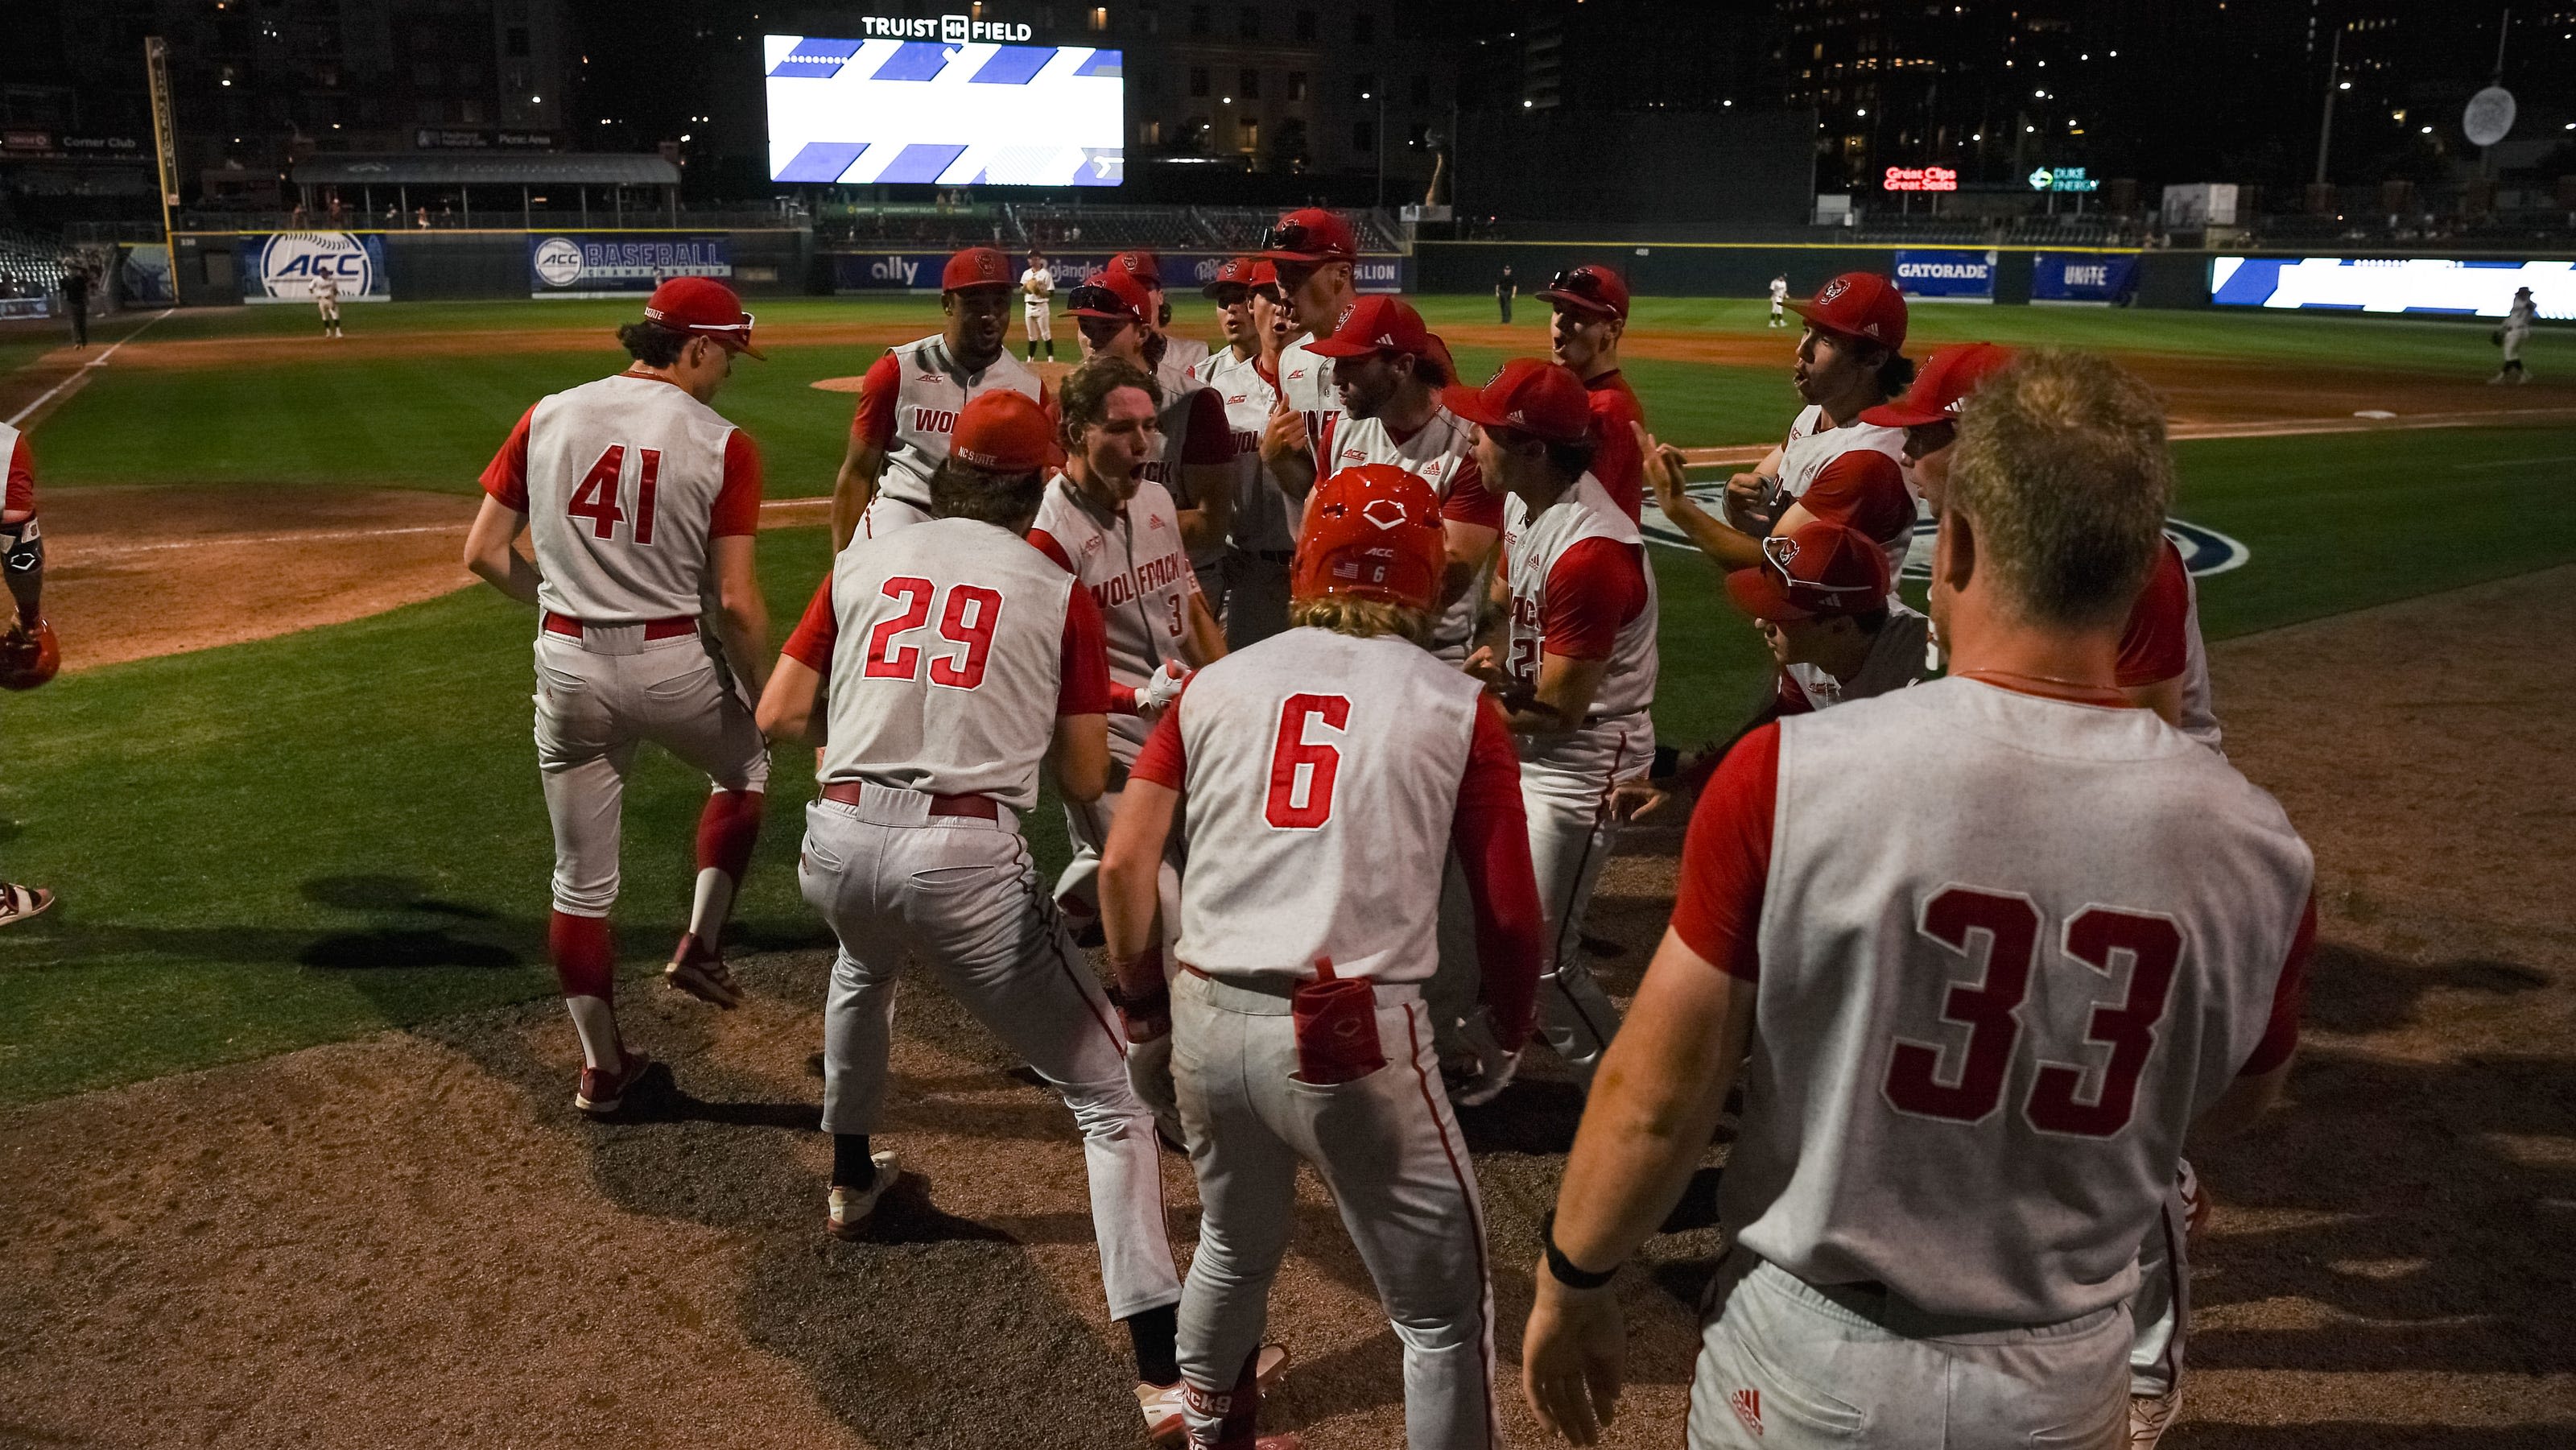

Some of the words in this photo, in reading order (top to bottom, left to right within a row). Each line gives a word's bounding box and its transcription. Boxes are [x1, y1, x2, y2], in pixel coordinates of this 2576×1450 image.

[861, 16, 938, 37] TRUIST
[972, 21, 1032, 41] FIELD
[64, 137, 105, 147] Corner
[108, 138, 136, 147] Club
[1885, 167, 1925, 180] Great
[1924, 167, 1957, 182] Clips
[2054, 167, 2085, 180] DUKE
[1883, 179, 1922, 191] Great
[1921, 179, 1957, 191] Seats
[276, 254, 362, 276] ACC
[542, 254, 578, 265] ACC
[584, 243, 724, 267] BASEBALL
[871, 256, 919, 285] ally
[1364, 265, 1396, 280] LION
[1897, 263, 1988, 279] GATORADE
[2063, 266, 2108, 286] UNITE
[916, 374, 943, 383] ACC
[1226, 395, 1247, 405] ACC
[958, 445, 968, 458] NC
[968, 451, 998, 465] STATE
[1341, 448, 1368, 461] ACC
[567, 441, 663, 547] 41
[1364, 547, 1394, 558] ACC
[1092, 551, 1180, 609] WOLFPACK
[1373, 566, 1385, 583] 6
[1167, 593, 1183, 638] 3
[861, 573, 1005, 692] 29
[1512, 636, 1546, 685] 2
[1261, 690, 1353, 832] 6
[1878, 880, 2188, 1140] 33
[1731, 1391, 1765, 1437] adidas
